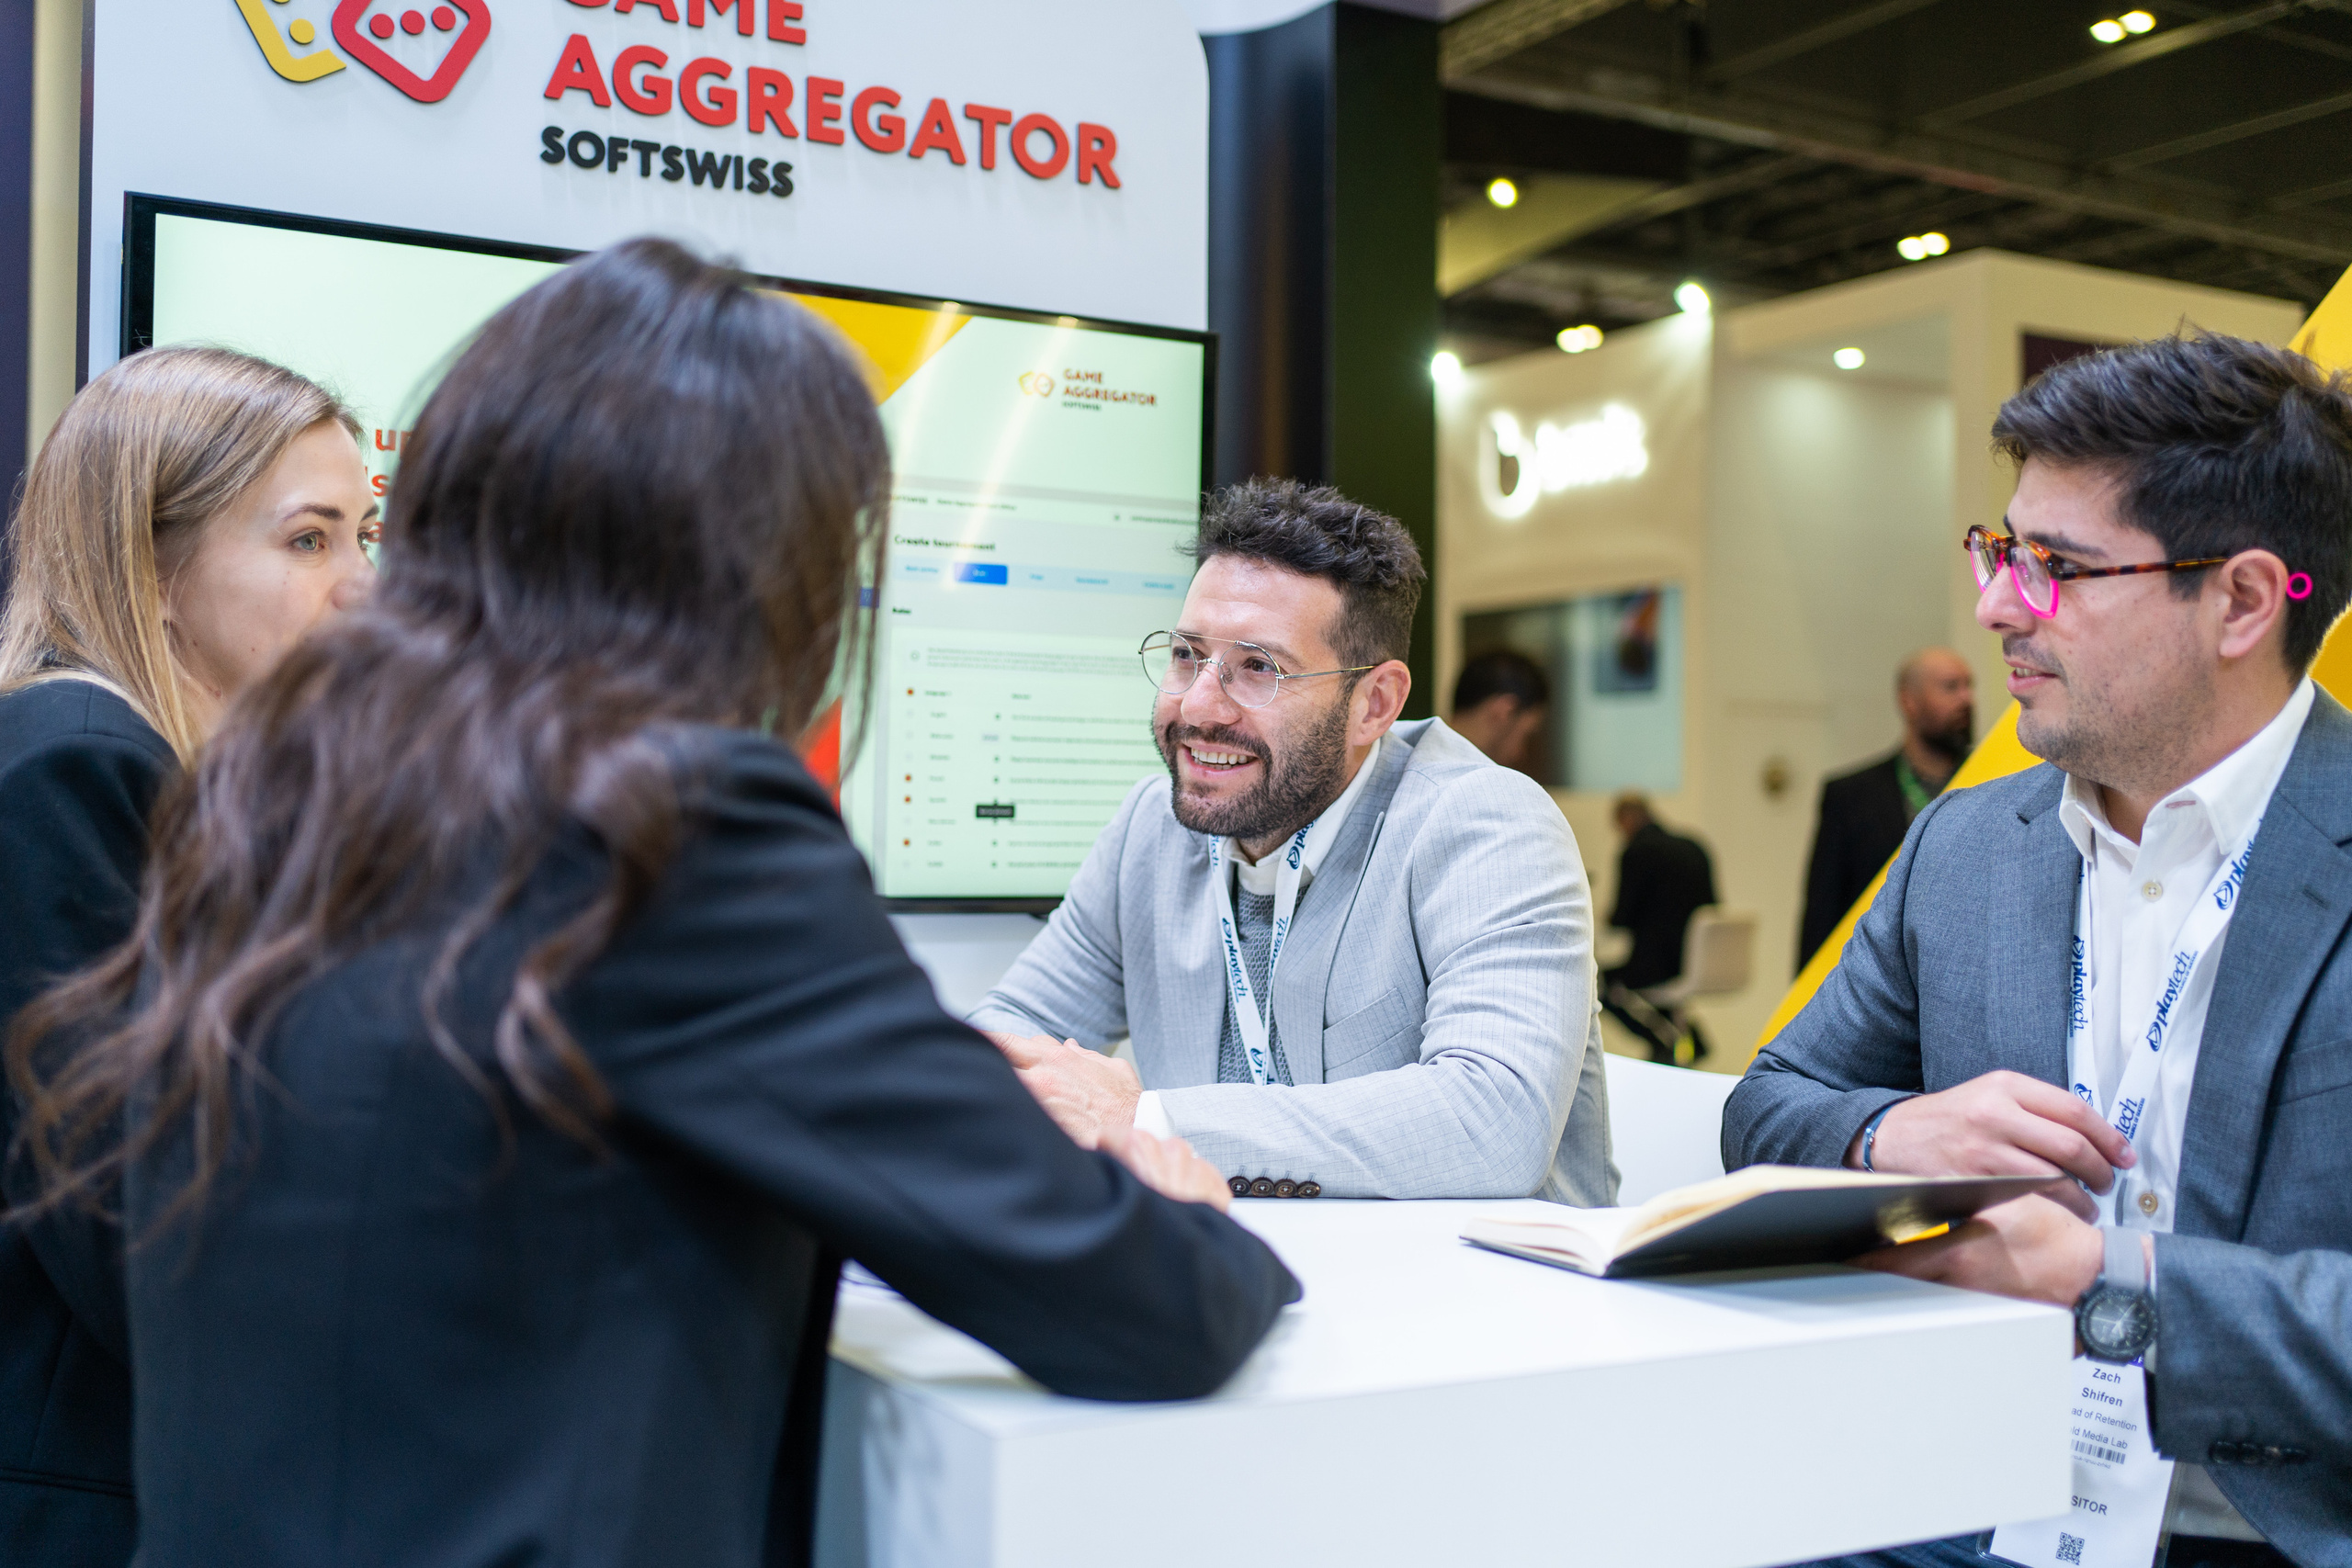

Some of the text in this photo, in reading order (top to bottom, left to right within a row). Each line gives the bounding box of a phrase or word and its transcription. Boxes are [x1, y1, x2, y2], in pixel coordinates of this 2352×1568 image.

[544, 33, 1121, 189] AGGREGATOR
[540, 126, 795, 197] SOFTSWISS
[2070, 961, 2088, 1031] playtech
[2155, 951, 2190, 1028] playtech
[2092, 1367, 2121, 1384] Zach
[2081, 1386, 2123, 1407] Shifren
[2084, 1410, 2094, 1419] of
[2094, 1412, 2137, 1431] Retention
[2082, 1428, 2109, 1444] Media
[2110, 1437, 2128, 1450] Lab
[2071, 1495, 2108, 1516] SITOR
